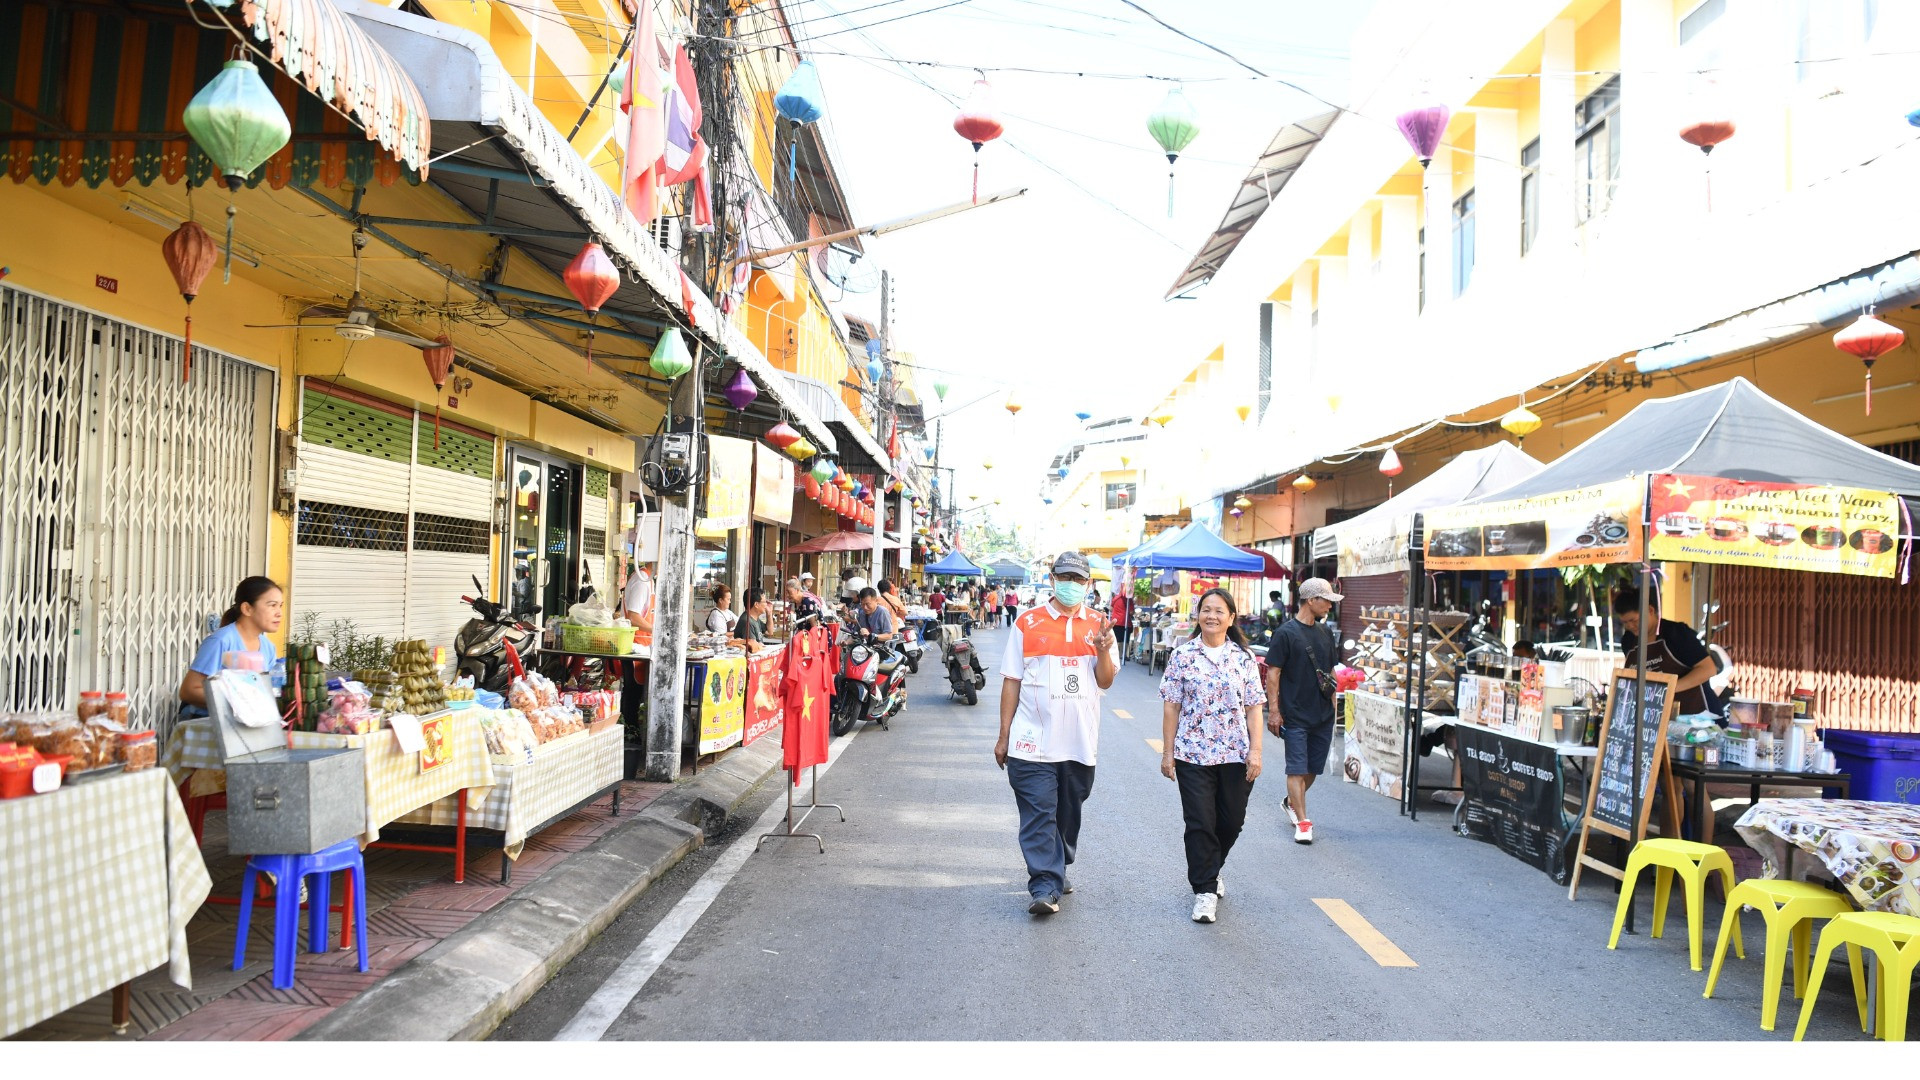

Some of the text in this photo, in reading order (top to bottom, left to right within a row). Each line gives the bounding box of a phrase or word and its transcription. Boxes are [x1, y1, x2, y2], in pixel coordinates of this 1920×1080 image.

[99, 277, 115, 290] 22/6
[1834, 493, 1884, 509] Nam
[1062, 659, 1078, 667] LEO
[1466, 747, 1555, 782] TEA SHOP COFFEE SHOP
